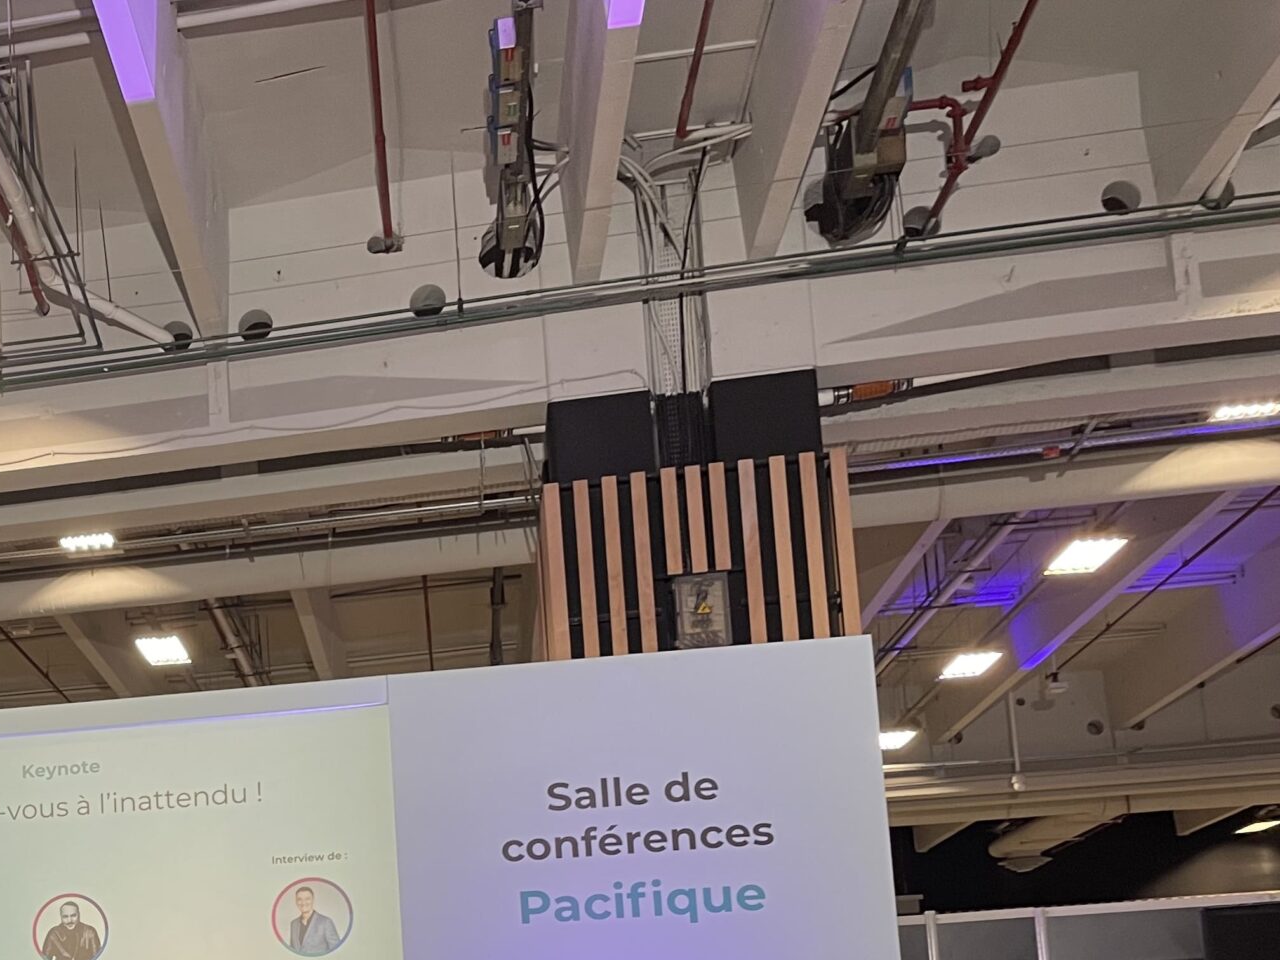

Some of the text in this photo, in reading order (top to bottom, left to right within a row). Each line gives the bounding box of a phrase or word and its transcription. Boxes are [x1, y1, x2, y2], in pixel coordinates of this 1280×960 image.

[22, 759, 101, 781] Keynote
[77, 795, 91, 816] à
[256, 781, 263, 803] !
[546, 771, 719, 812] Salle de
[272, 853, 325, 865] Interview
[327, 851, 342, 861] de
[501, 822, 775, 862] conférences
[520, 879, 766, 924] Pacifique
